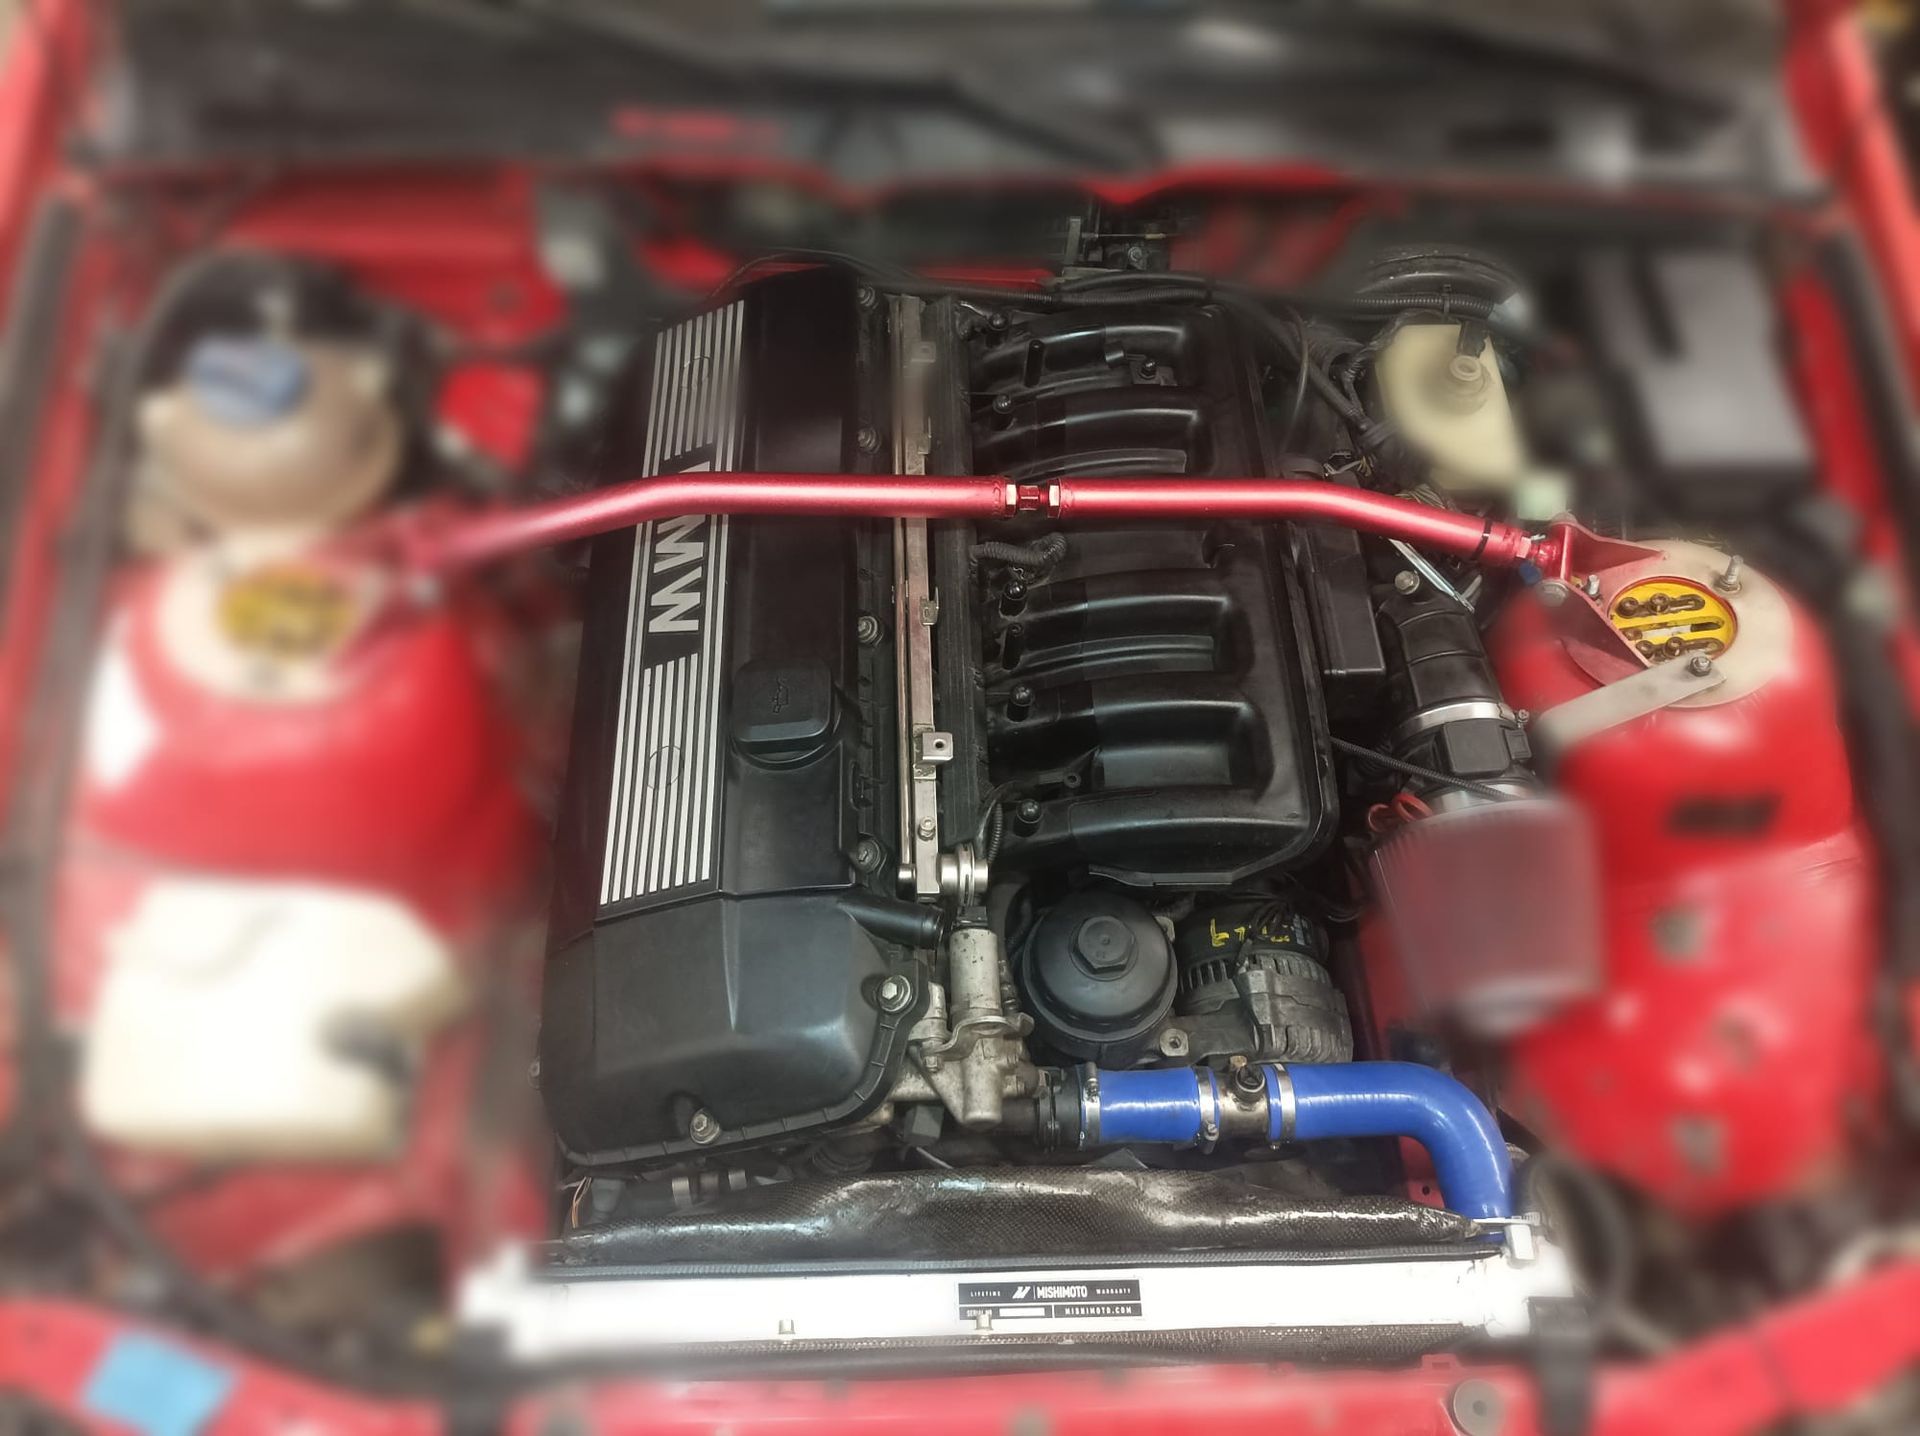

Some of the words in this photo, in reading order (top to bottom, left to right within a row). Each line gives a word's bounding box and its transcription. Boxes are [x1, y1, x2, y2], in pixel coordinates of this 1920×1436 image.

[648, 460, 711, 633] MW
[970, 1290, 1001, 1298] LIFETIME
[1036, 1285, 1088, 1299] MISHIMOTO
[1096, 1287, 1131, 1295] WARRANTY
[1064, 1306, 1132, 1316] MISHIMOTO.COM
